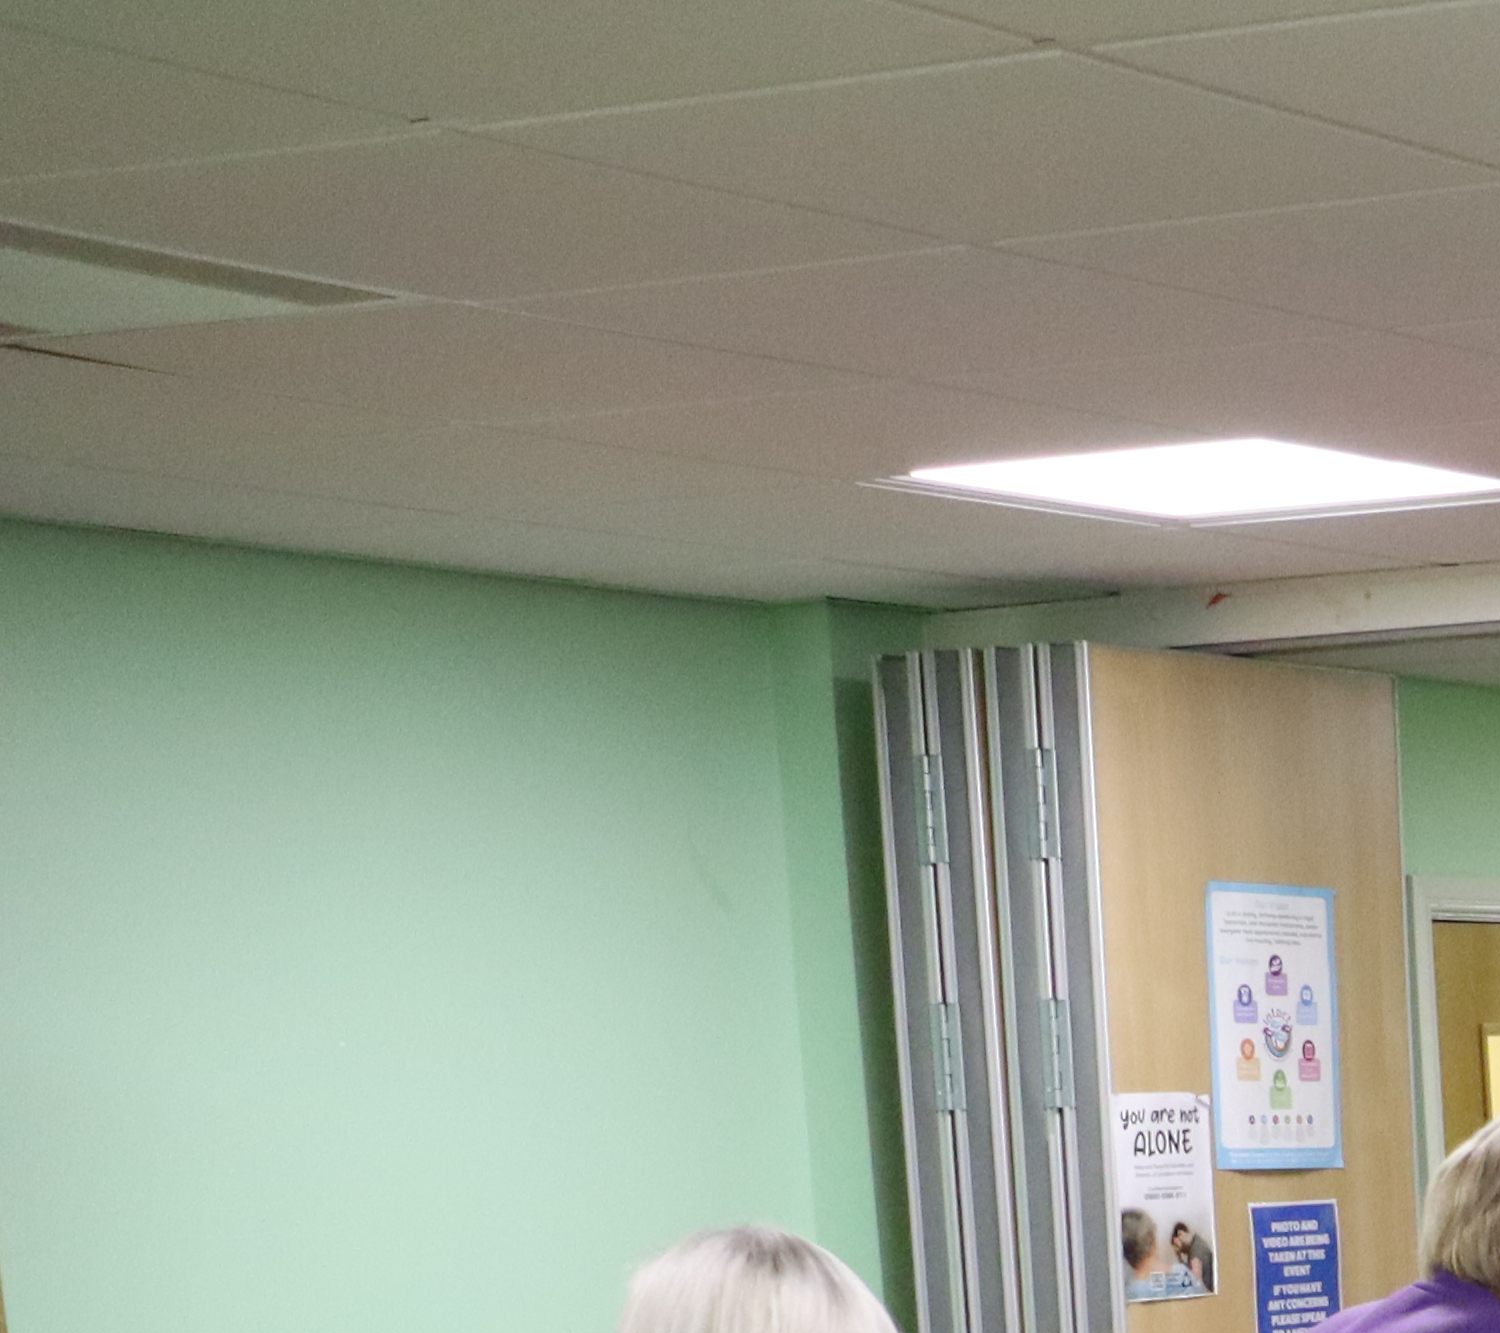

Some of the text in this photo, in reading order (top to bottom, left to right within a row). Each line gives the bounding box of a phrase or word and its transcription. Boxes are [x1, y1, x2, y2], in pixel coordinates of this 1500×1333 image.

[1120, 1105, 1200, 1130] you are not
[1133, 1128, 1193, 1157] ALONE
[1271, 1220, 1318, 1232] PHOTO AND
[1262, 1236, 1289, 1248] VIDEO
[1289, 1235, 1305, 1246] ARE
[1268, 1251, 1296, 1263] TAKEN
[1296, 1250, 1307, 1261] AT
[1283, 1264, 1311, 1276] EVENT
[1281, 1284, 1299, 1295] YOU
[1299, 1281, 1322, 1294] HAVE
[1267, 1299, 1286, 1311] ANY
[1271, 1313, 1301, 1326] PLEASE
